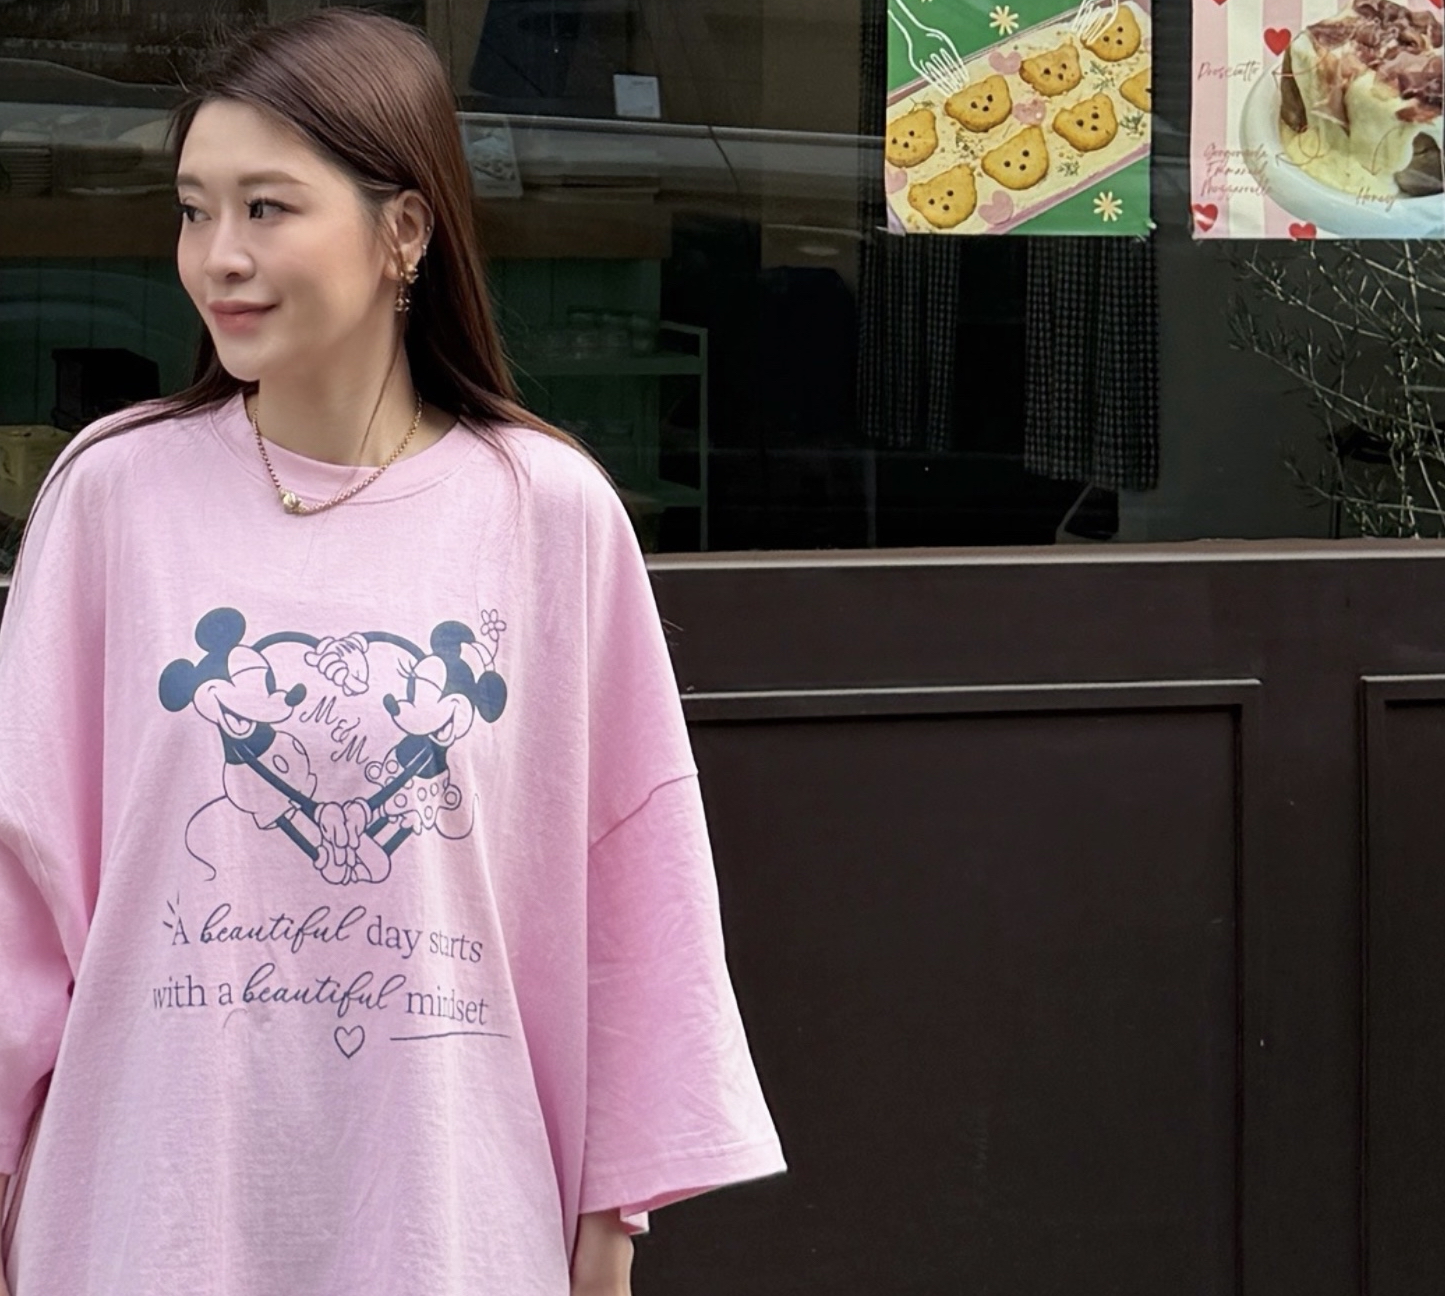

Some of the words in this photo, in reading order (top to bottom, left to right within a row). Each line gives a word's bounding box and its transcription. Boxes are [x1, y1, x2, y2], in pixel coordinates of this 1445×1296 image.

[171, 917, 191, 946] A
[200, 903, 367, 954] beautiful
[366, 915, 423, 960] day
[153, 974, 207, 1008] with
[218, 981, 235, 1006] a
[242, 962, 406, 1018] beautiful
